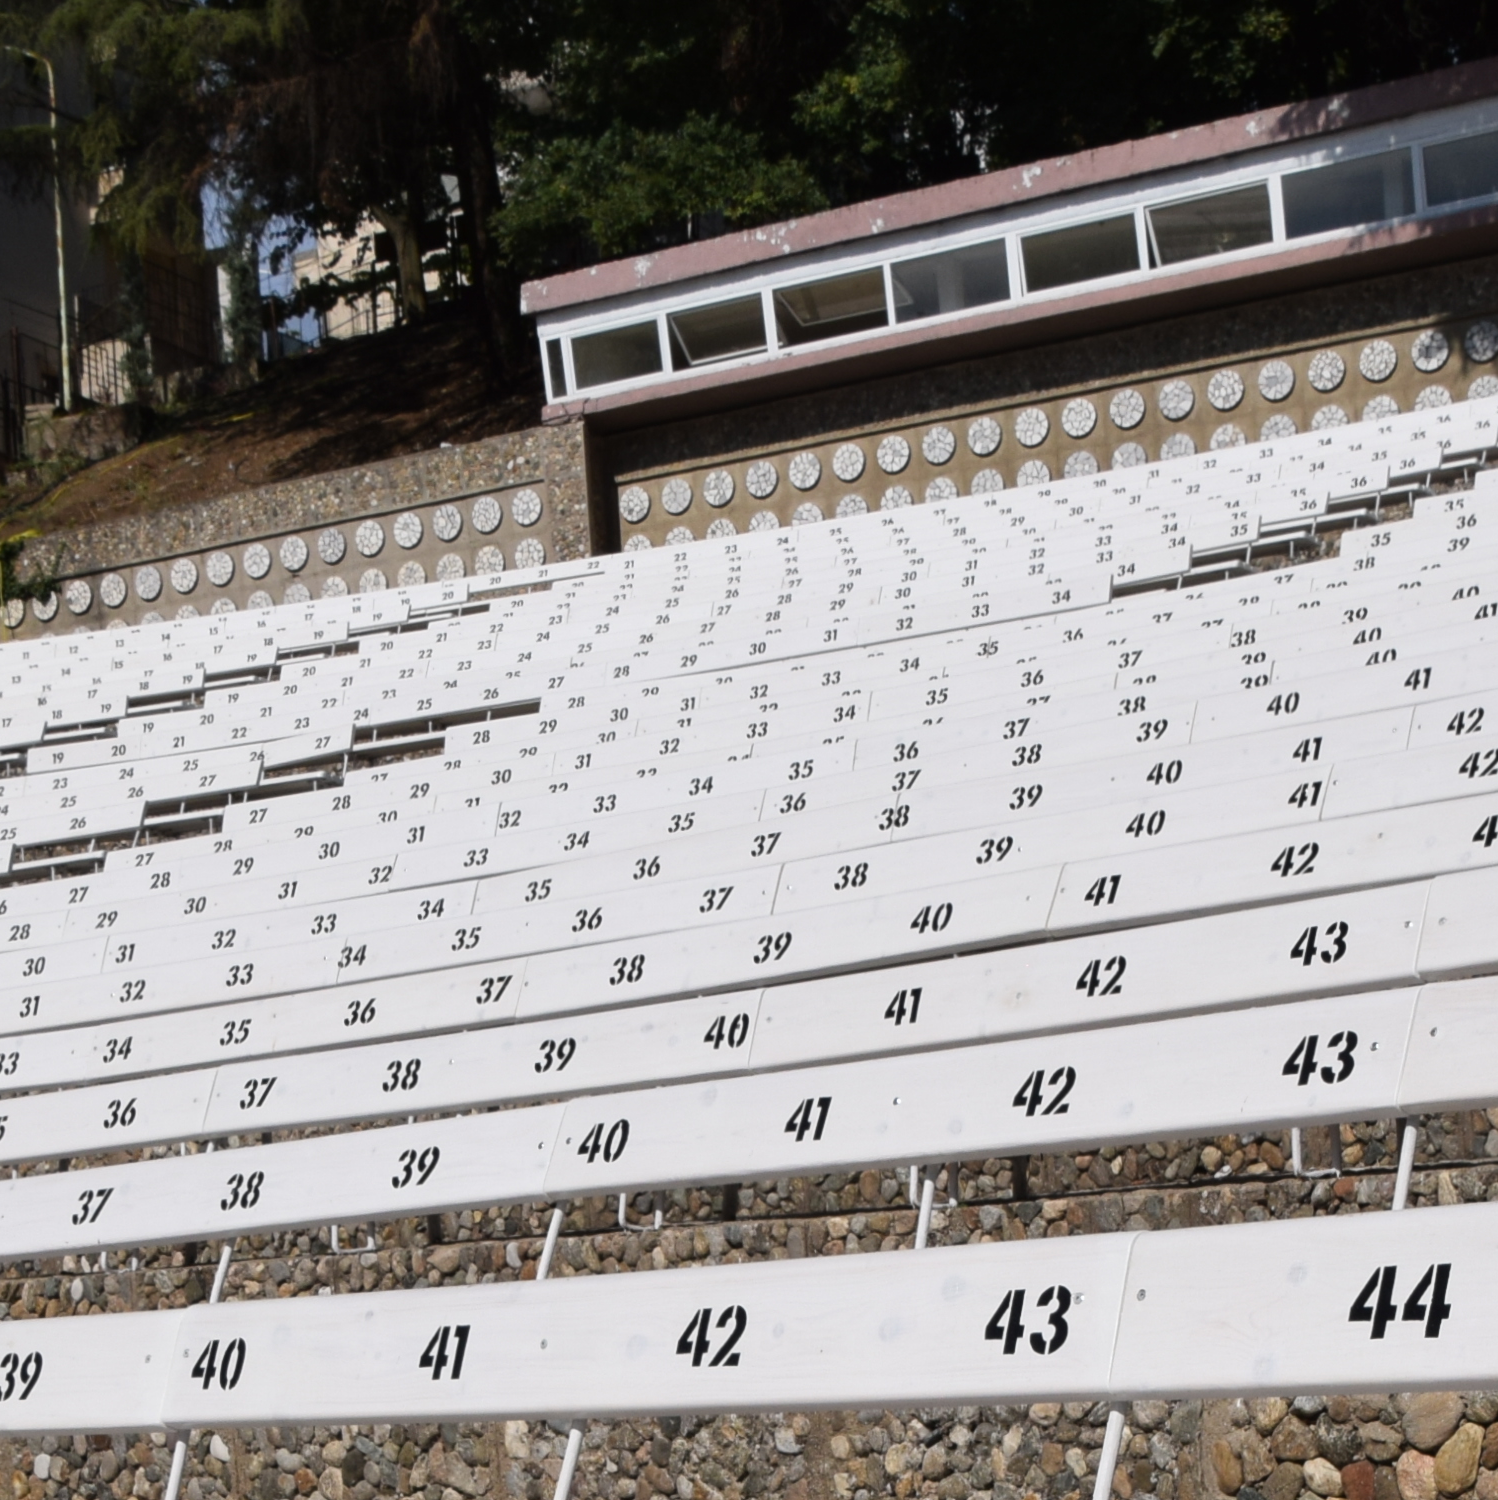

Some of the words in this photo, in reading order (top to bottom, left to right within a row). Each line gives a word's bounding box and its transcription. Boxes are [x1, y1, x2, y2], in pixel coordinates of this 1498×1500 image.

[103, 1037, 132, 1062] 34
[220, 1019, 251, 1045] 35
[344, 999, 375, 1026] 36
[477, 976, 512, 1004] 37
[610, 955, 645, 985] 38
[754, 932, 792, 963] 39
[911, 903, 952, 933] 40
[1085, 875, 1121, 906] 41
[1271, 843, 1319, 877] 42
[104, 1099, 136, 1128] 36
[240, 1077, 277, 1109] 37
[383, 1059, 421, 1091] 38
[535, 1038, 576, 1072] 39
[704, 1014, 749, 1049] 40
[885, 988, 922, 1025] 41
[1076, 956, 1126, 996] 42
[1291, 922, 1348, 965] 43
[72, 1188, 113, 1225] 37
[221, 1172, 264, 1210] 38
[392, 1147, 439, 1188] 39
[578, 1119, 629, 1163] 40
[785, 1097, 831, 1141] 41
[1013, 1067, 1076, 1116] 42
[1282, 1031, 1357, 1085] 43
[192, 1338, 246, 1389] 40
[419, 1325, 470, 1380] 41
[676, 1306, 747, 1366] 42
[985, 1286, 1071, 1354] 43
[1349, 1264, 1451, 1339] 44
